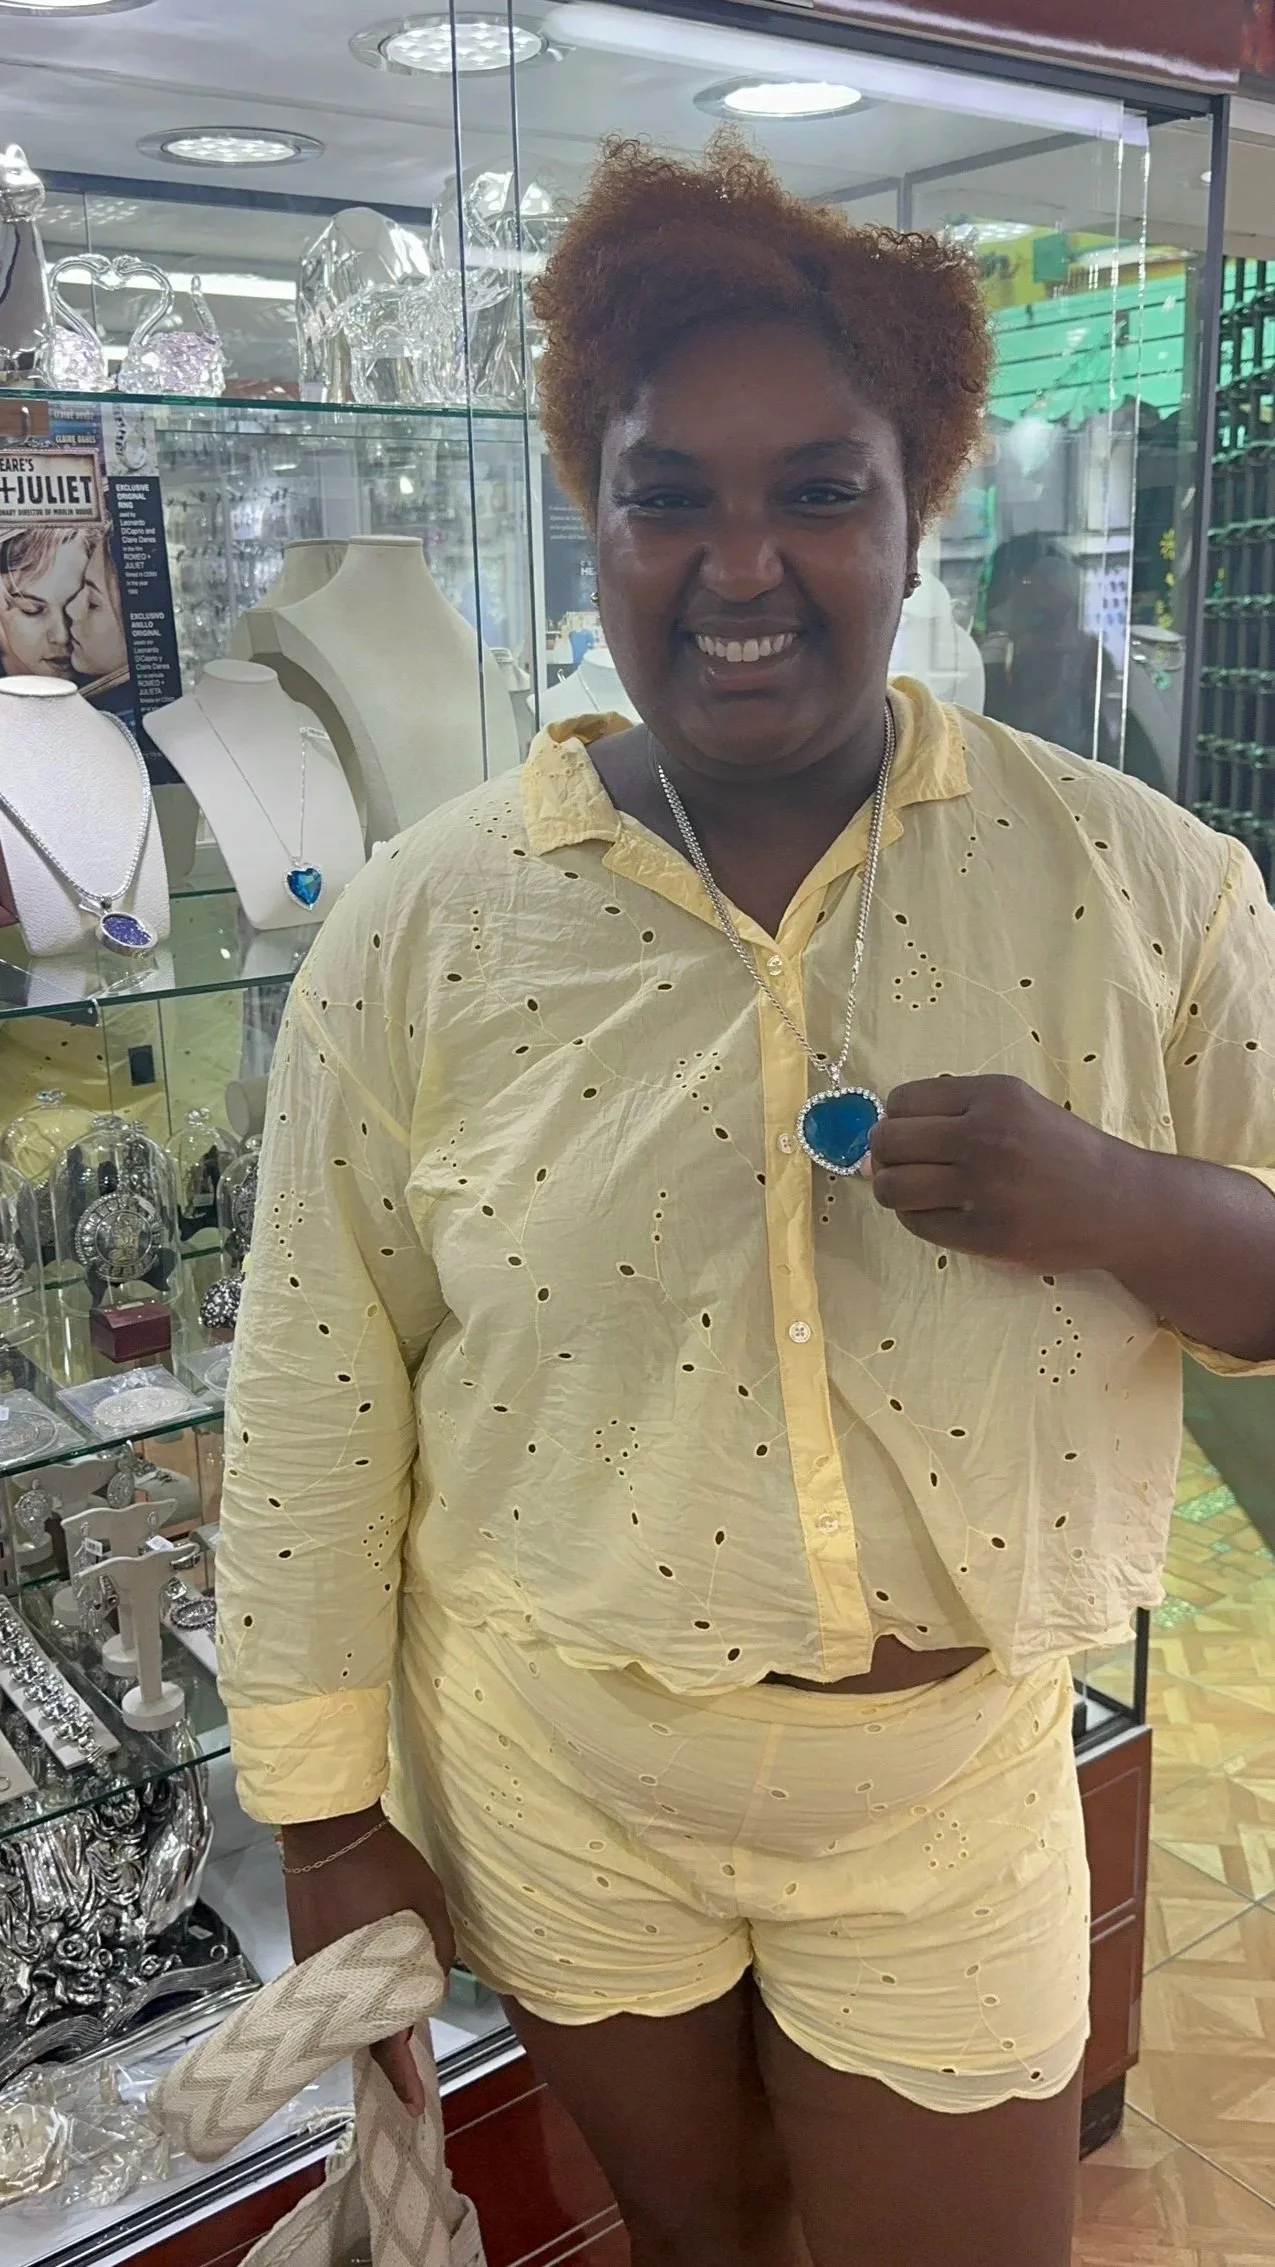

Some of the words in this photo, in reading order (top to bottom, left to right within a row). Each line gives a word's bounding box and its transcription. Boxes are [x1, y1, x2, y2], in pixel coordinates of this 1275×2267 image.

[18, 508, 43, 516] DIRECTOR
[45, 508, 52, 516] OF
[131, 620, 154, 628] ANILLO
